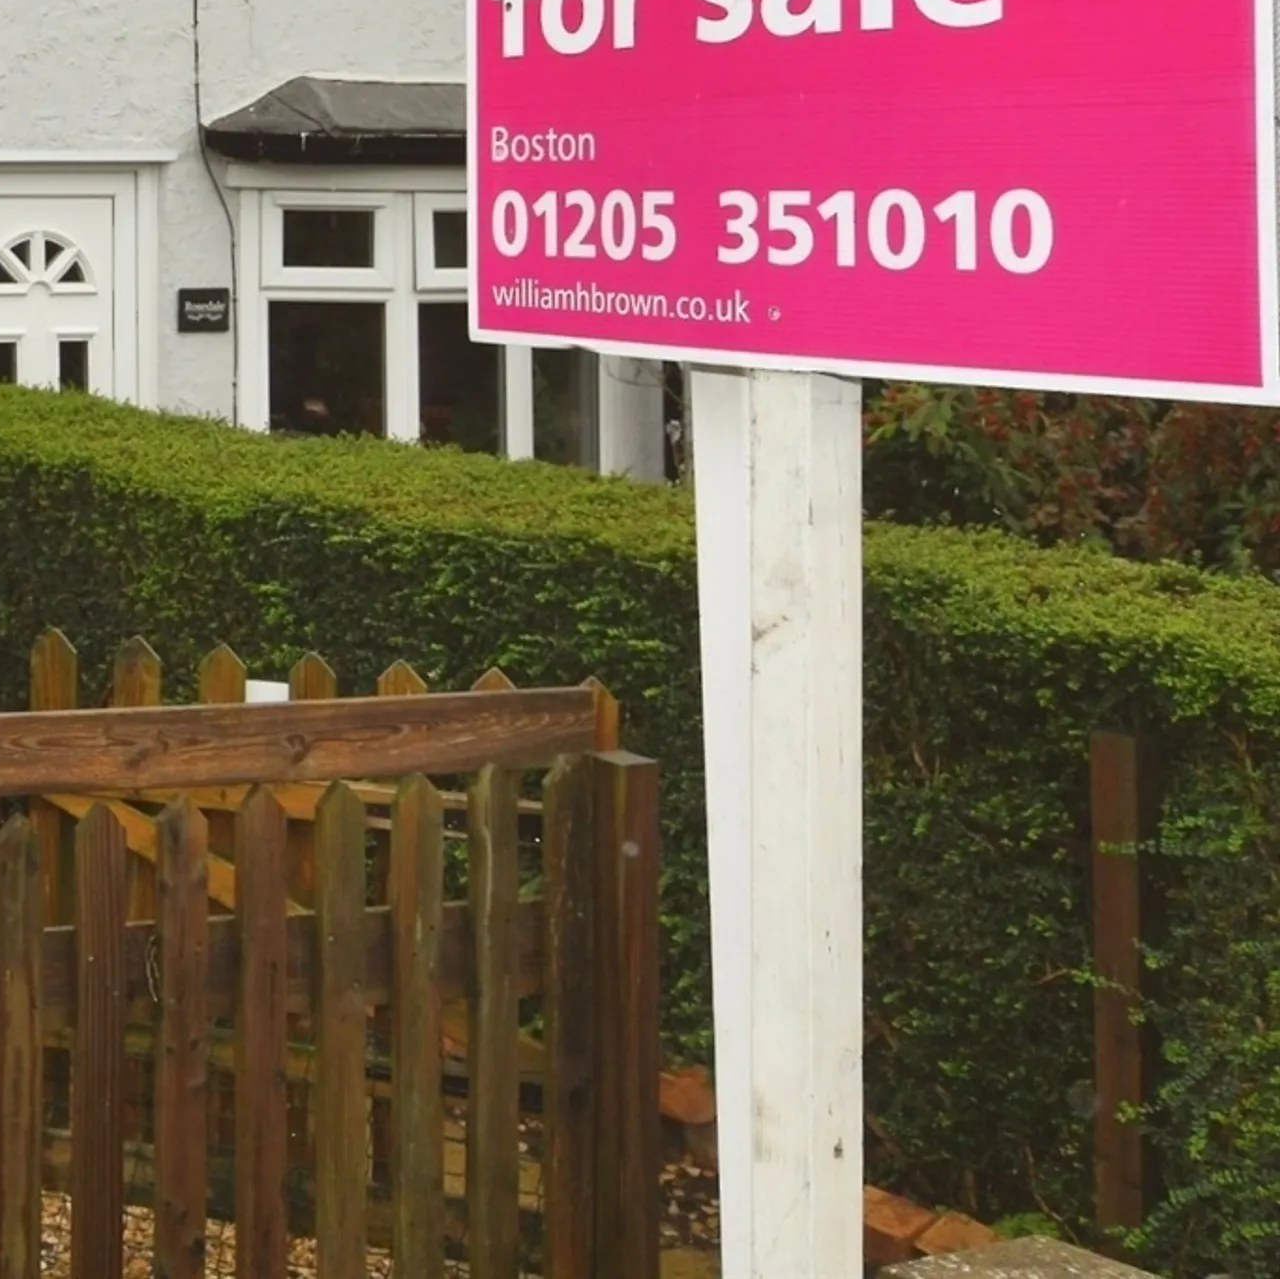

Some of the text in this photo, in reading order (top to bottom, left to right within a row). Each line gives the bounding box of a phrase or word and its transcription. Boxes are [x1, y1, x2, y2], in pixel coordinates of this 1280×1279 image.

[490, 125, 596, 163] Boston
[491, 187, 1055, 275] 01205 351010
[491, 278, 752, 324] williamhbrown.co.uk
